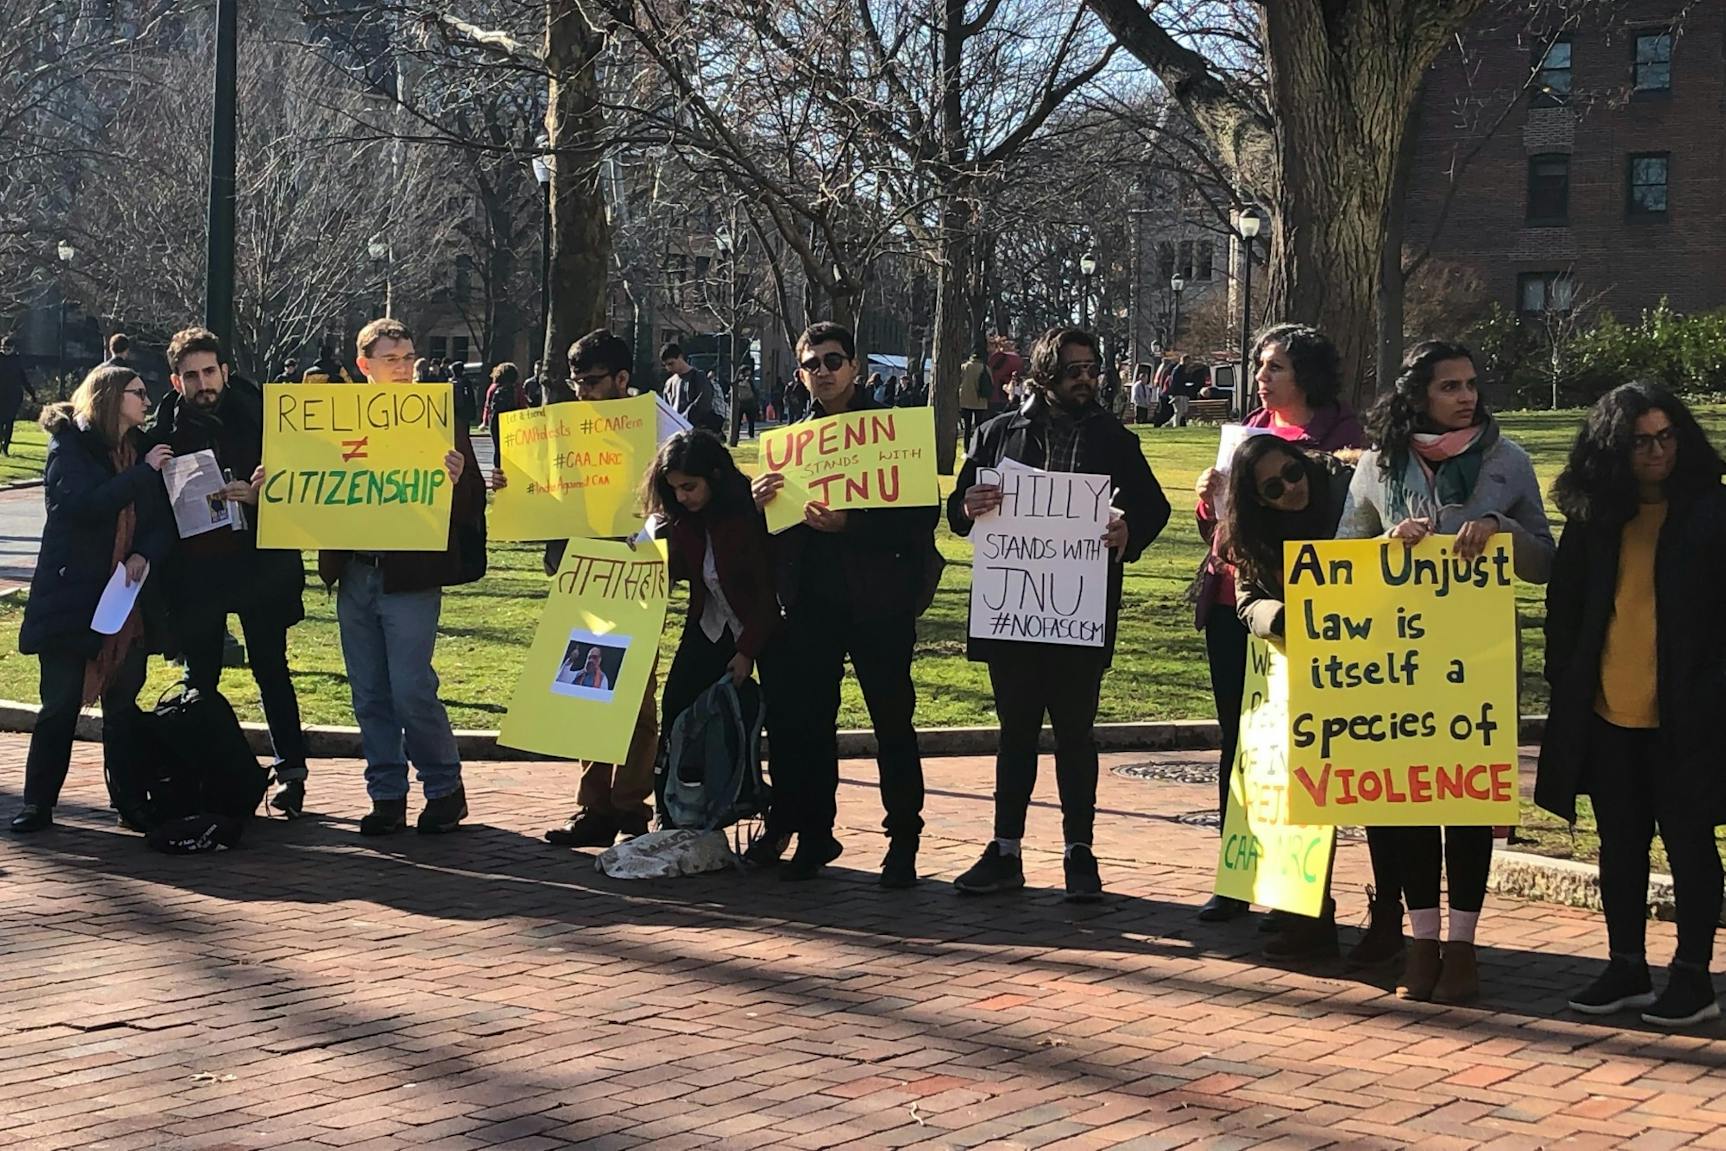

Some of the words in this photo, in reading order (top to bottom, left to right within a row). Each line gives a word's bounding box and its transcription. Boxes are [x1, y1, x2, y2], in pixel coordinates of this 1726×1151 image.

[278, 392, 448, 432] RELIGION
[766, 414, 896, 471] UPENN
[803, 454, 860, 477] STANDS
[879, 448, 922, 462] WITH
[264, 469, 445, 506] CITIZENSHIP
[808, 465, 899, 507] JNU
[983, 533, 1057, 560] STANDS
[1063, 539, 1101, 560] WITH
[1288, 544, 1353, 586] An
[1380, 541, 1511, 597] Unjust
[983, 566, 1083, 616] JNU
[989, 612, 1104, 642] #NOFASCISM
[1304, 599, 1372, 640] law
[1397, 607, 1425, 639] is
[1251, 641, 1277, 677] WE
[1311, 650, 1419, 689] itself
[1446, 659, 1465, 684] a
[1450, 702, 1497, 746] of
[1293, 763, 1512, 807] VIOLENCE
